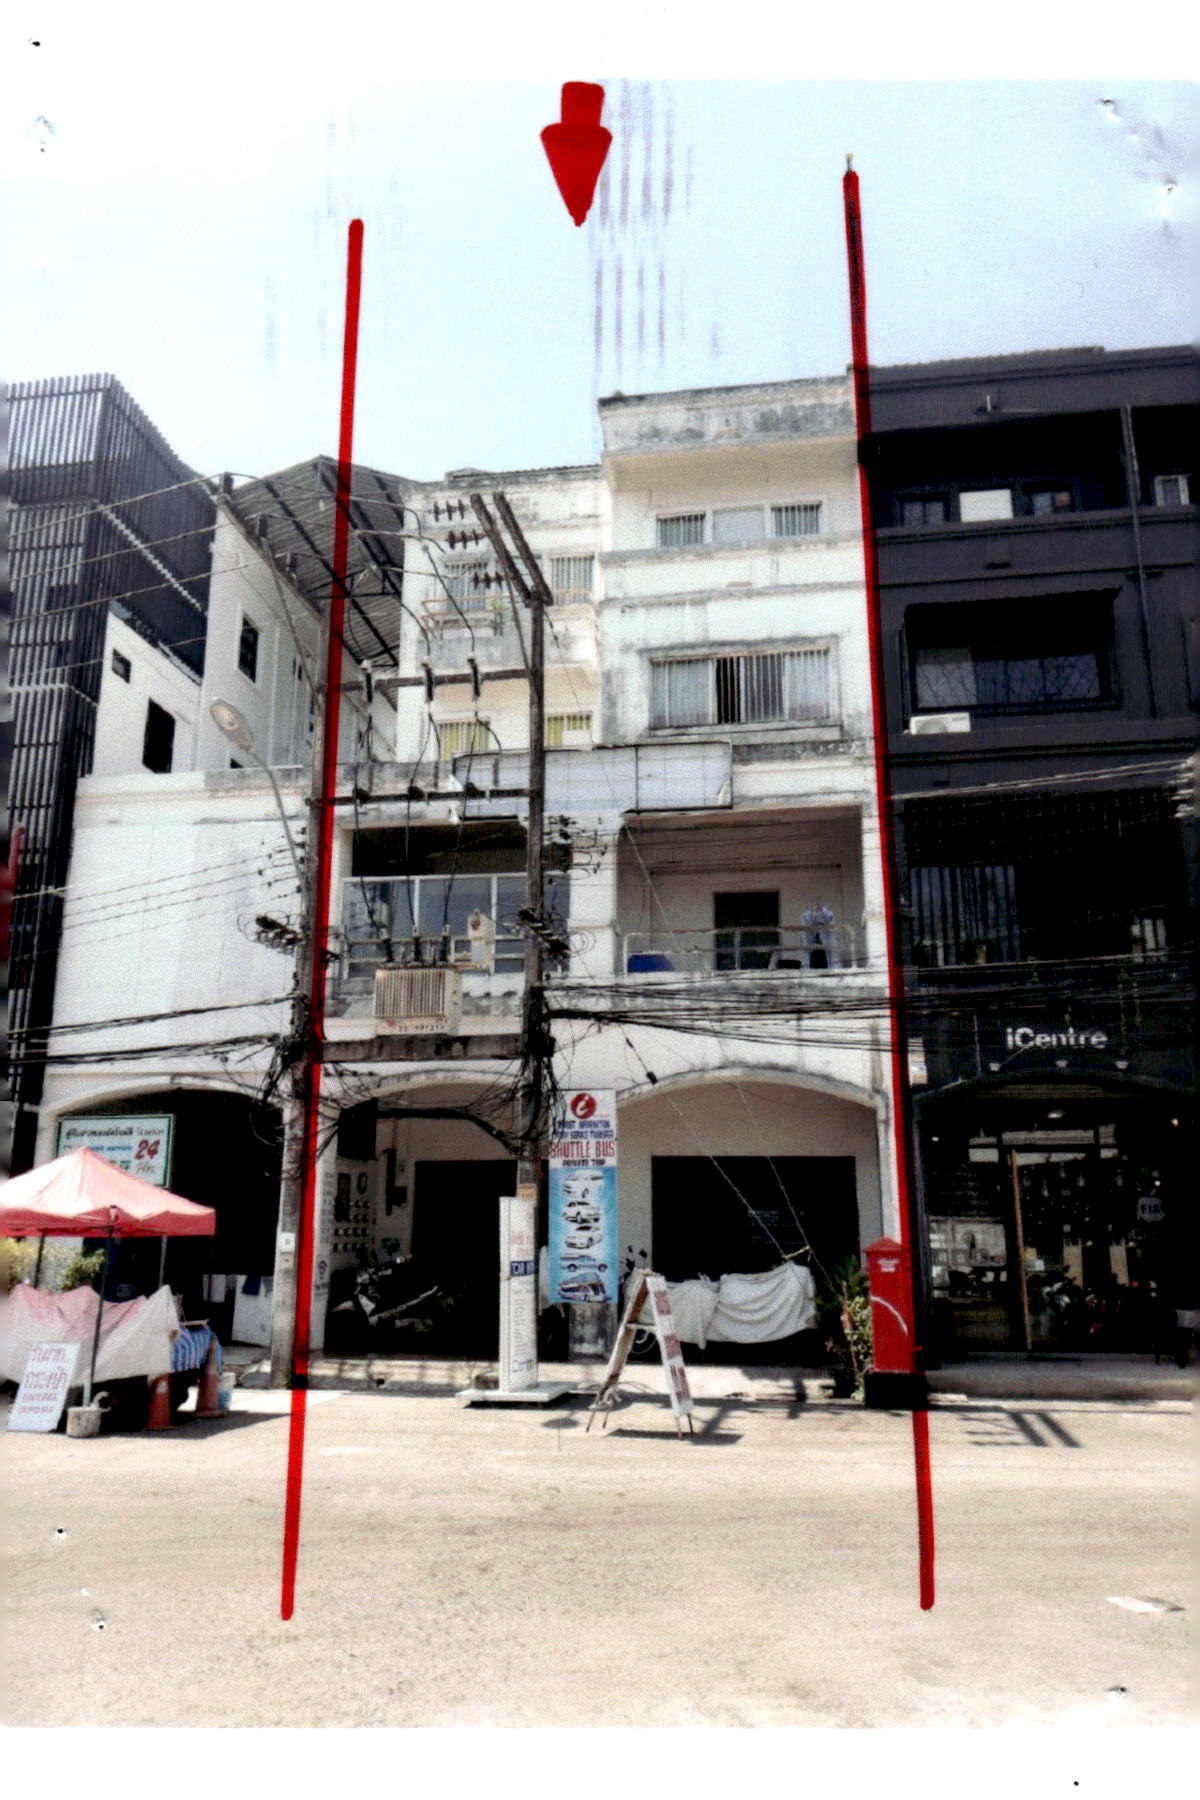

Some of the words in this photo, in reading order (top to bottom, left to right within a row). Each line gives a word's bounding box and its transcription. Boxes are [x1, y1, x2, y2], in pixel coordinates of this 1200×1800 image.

[1006, 1027, 1108, 1049] iCentre
[134, 1139, 161, 1160] 24
[551, 1140, 590, 1159] SHUTTLE
[595, 1140, 615, 1158] BUS
